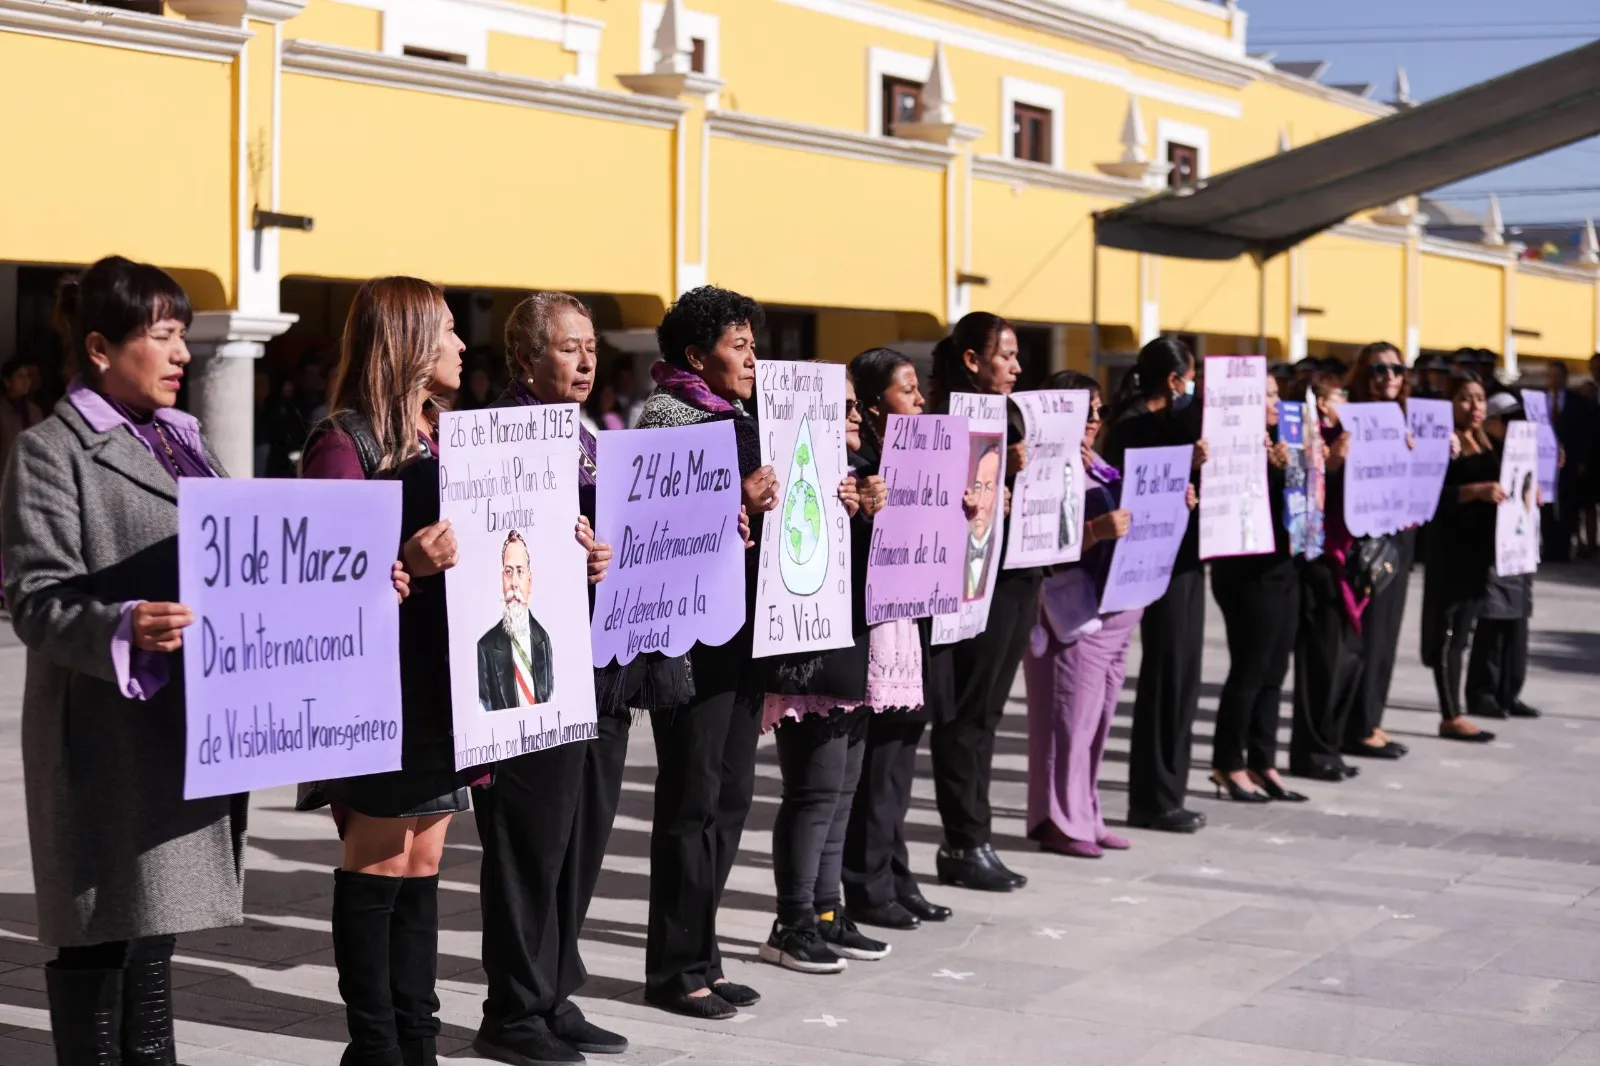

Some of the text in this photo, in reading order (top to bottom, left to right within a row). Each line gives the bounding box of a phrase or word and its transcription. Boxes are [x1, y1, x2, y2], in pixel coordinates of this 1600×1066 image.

[761, 363, 778, 391] 22
[780, 366, 790, 391] de
[791, 364, 811, 392] Marzo
[764, 392, 839, 433] Mundial del Agua
[965, 397, 975, 418] de
[450, 408, 574, 447] 26 de Marzo de 1913
[892, 418, 910, 450] 21
[501, 460, 511, 495] del
[513, 456, 538, 493] Plan
[543, 456, 557, 490] de
[628, 449, 731, 502] 24 de Marzo
[922, 475, 933, 506] de
[936, 473, 948, 507] la
[487, 497, 535, 533] Guadalupe
[201, 514, 368, 588] 31 de Marzo
[619, 515, 727, 569] Día Internacional
[914, 534, 928, 565] de
[933, 531, 946, 564] la
[604, 574, 706, 631] del derecho a la
[928, 582, 958, 616] étnica
[239, 606, 364, 672] Internacional
[627, 624, 670, 657] Verdad
[768, 602, 831, 641] Es Vida
[199, 698, 398, 766] de Visibilidad Transgénero
[505, 738, 518, 759] por
